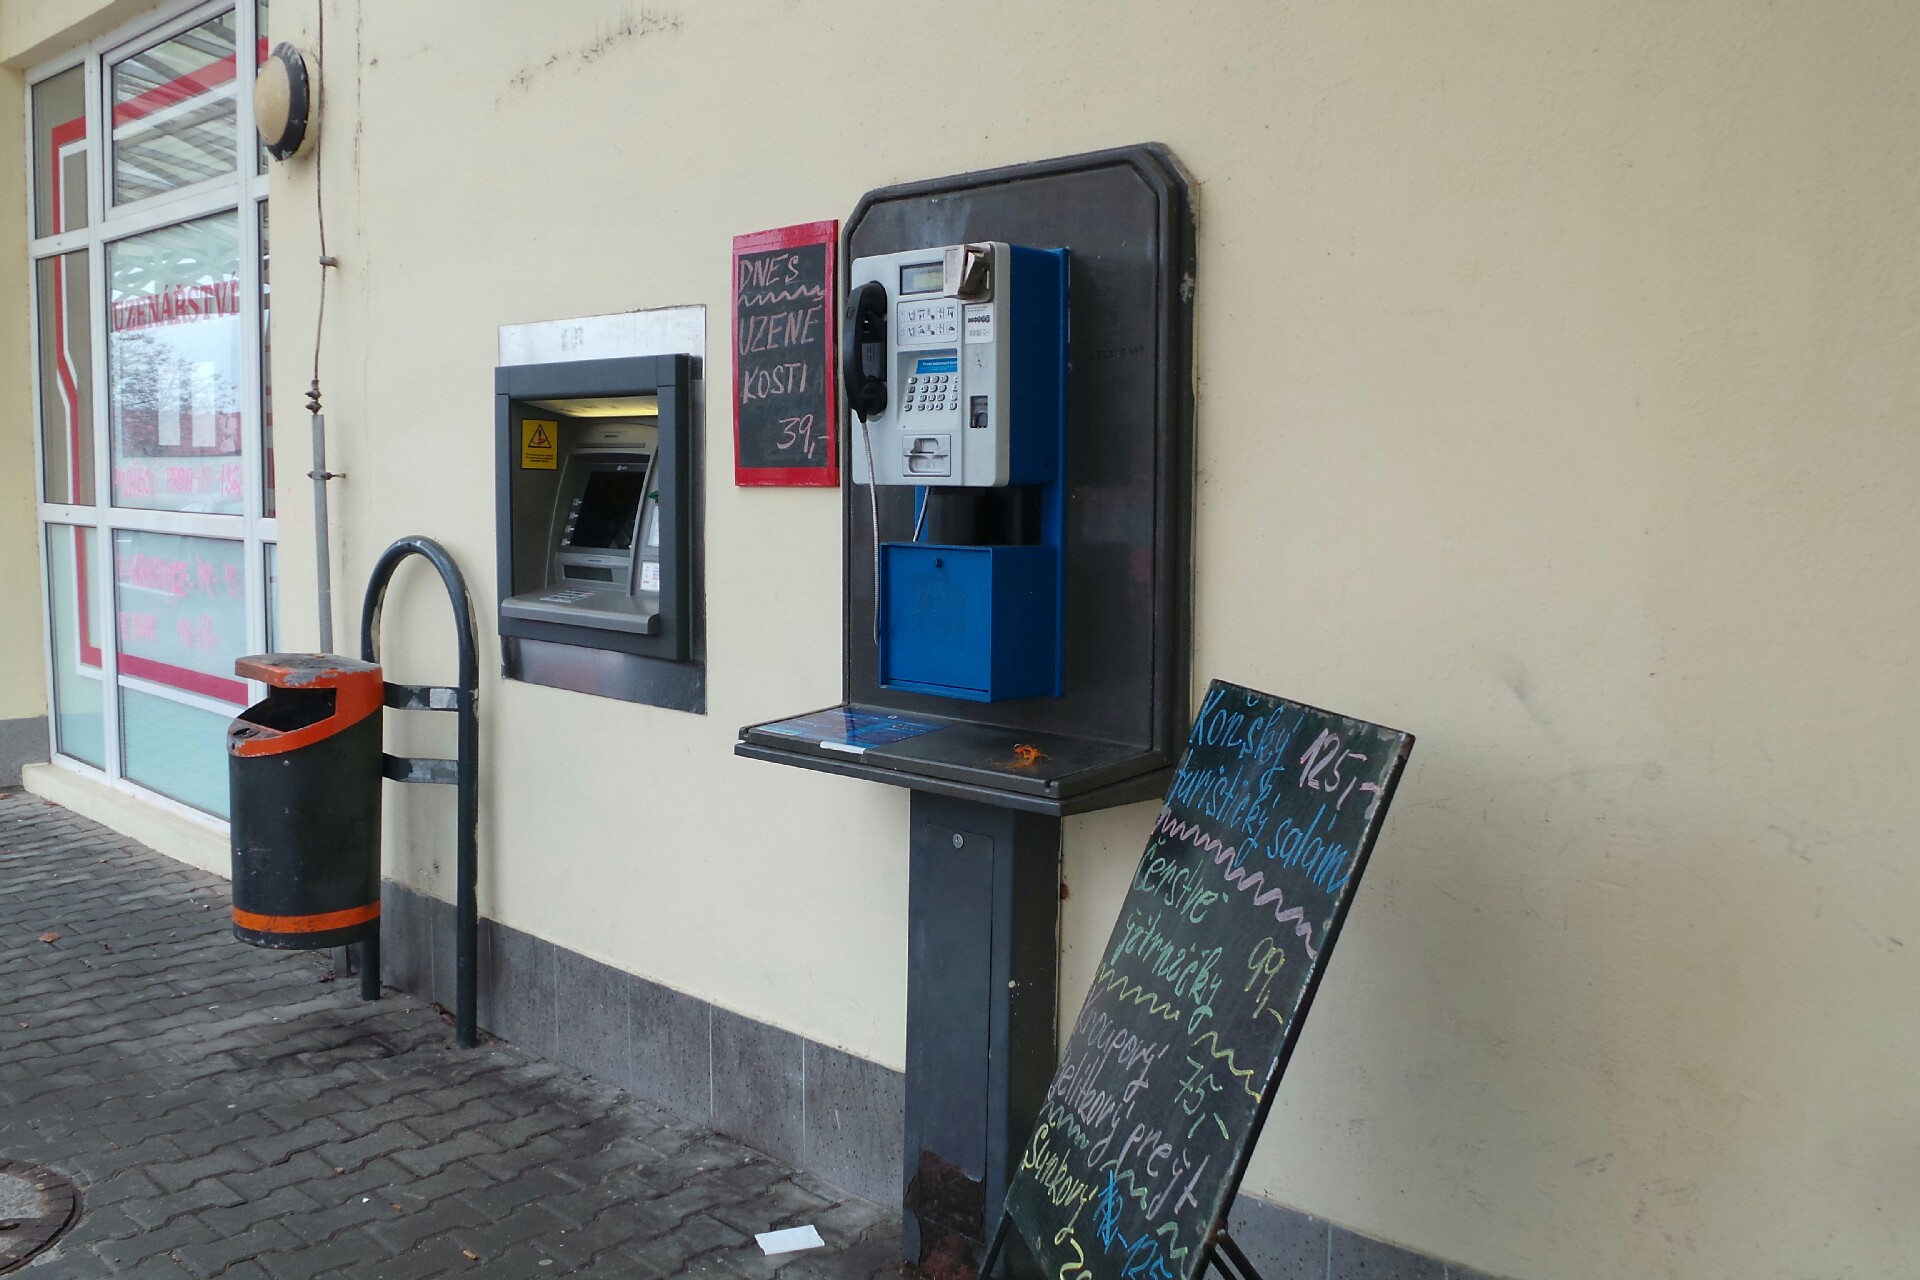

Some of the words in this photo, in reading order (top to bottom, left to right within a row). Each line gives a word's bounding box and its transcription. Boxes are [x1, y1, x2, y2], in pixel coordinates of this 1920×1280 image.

[112, 271, 240, 331] UZENÁŘSTVÍ
[739, 252, 799, 293] DNES
[739, 296, 823, 356] UZENÉ
[741, 361, 808, 404] KOSTI
[1188, 689, 1304, 791] Koňský
[1300, 727, 1382, 811] 125,-
